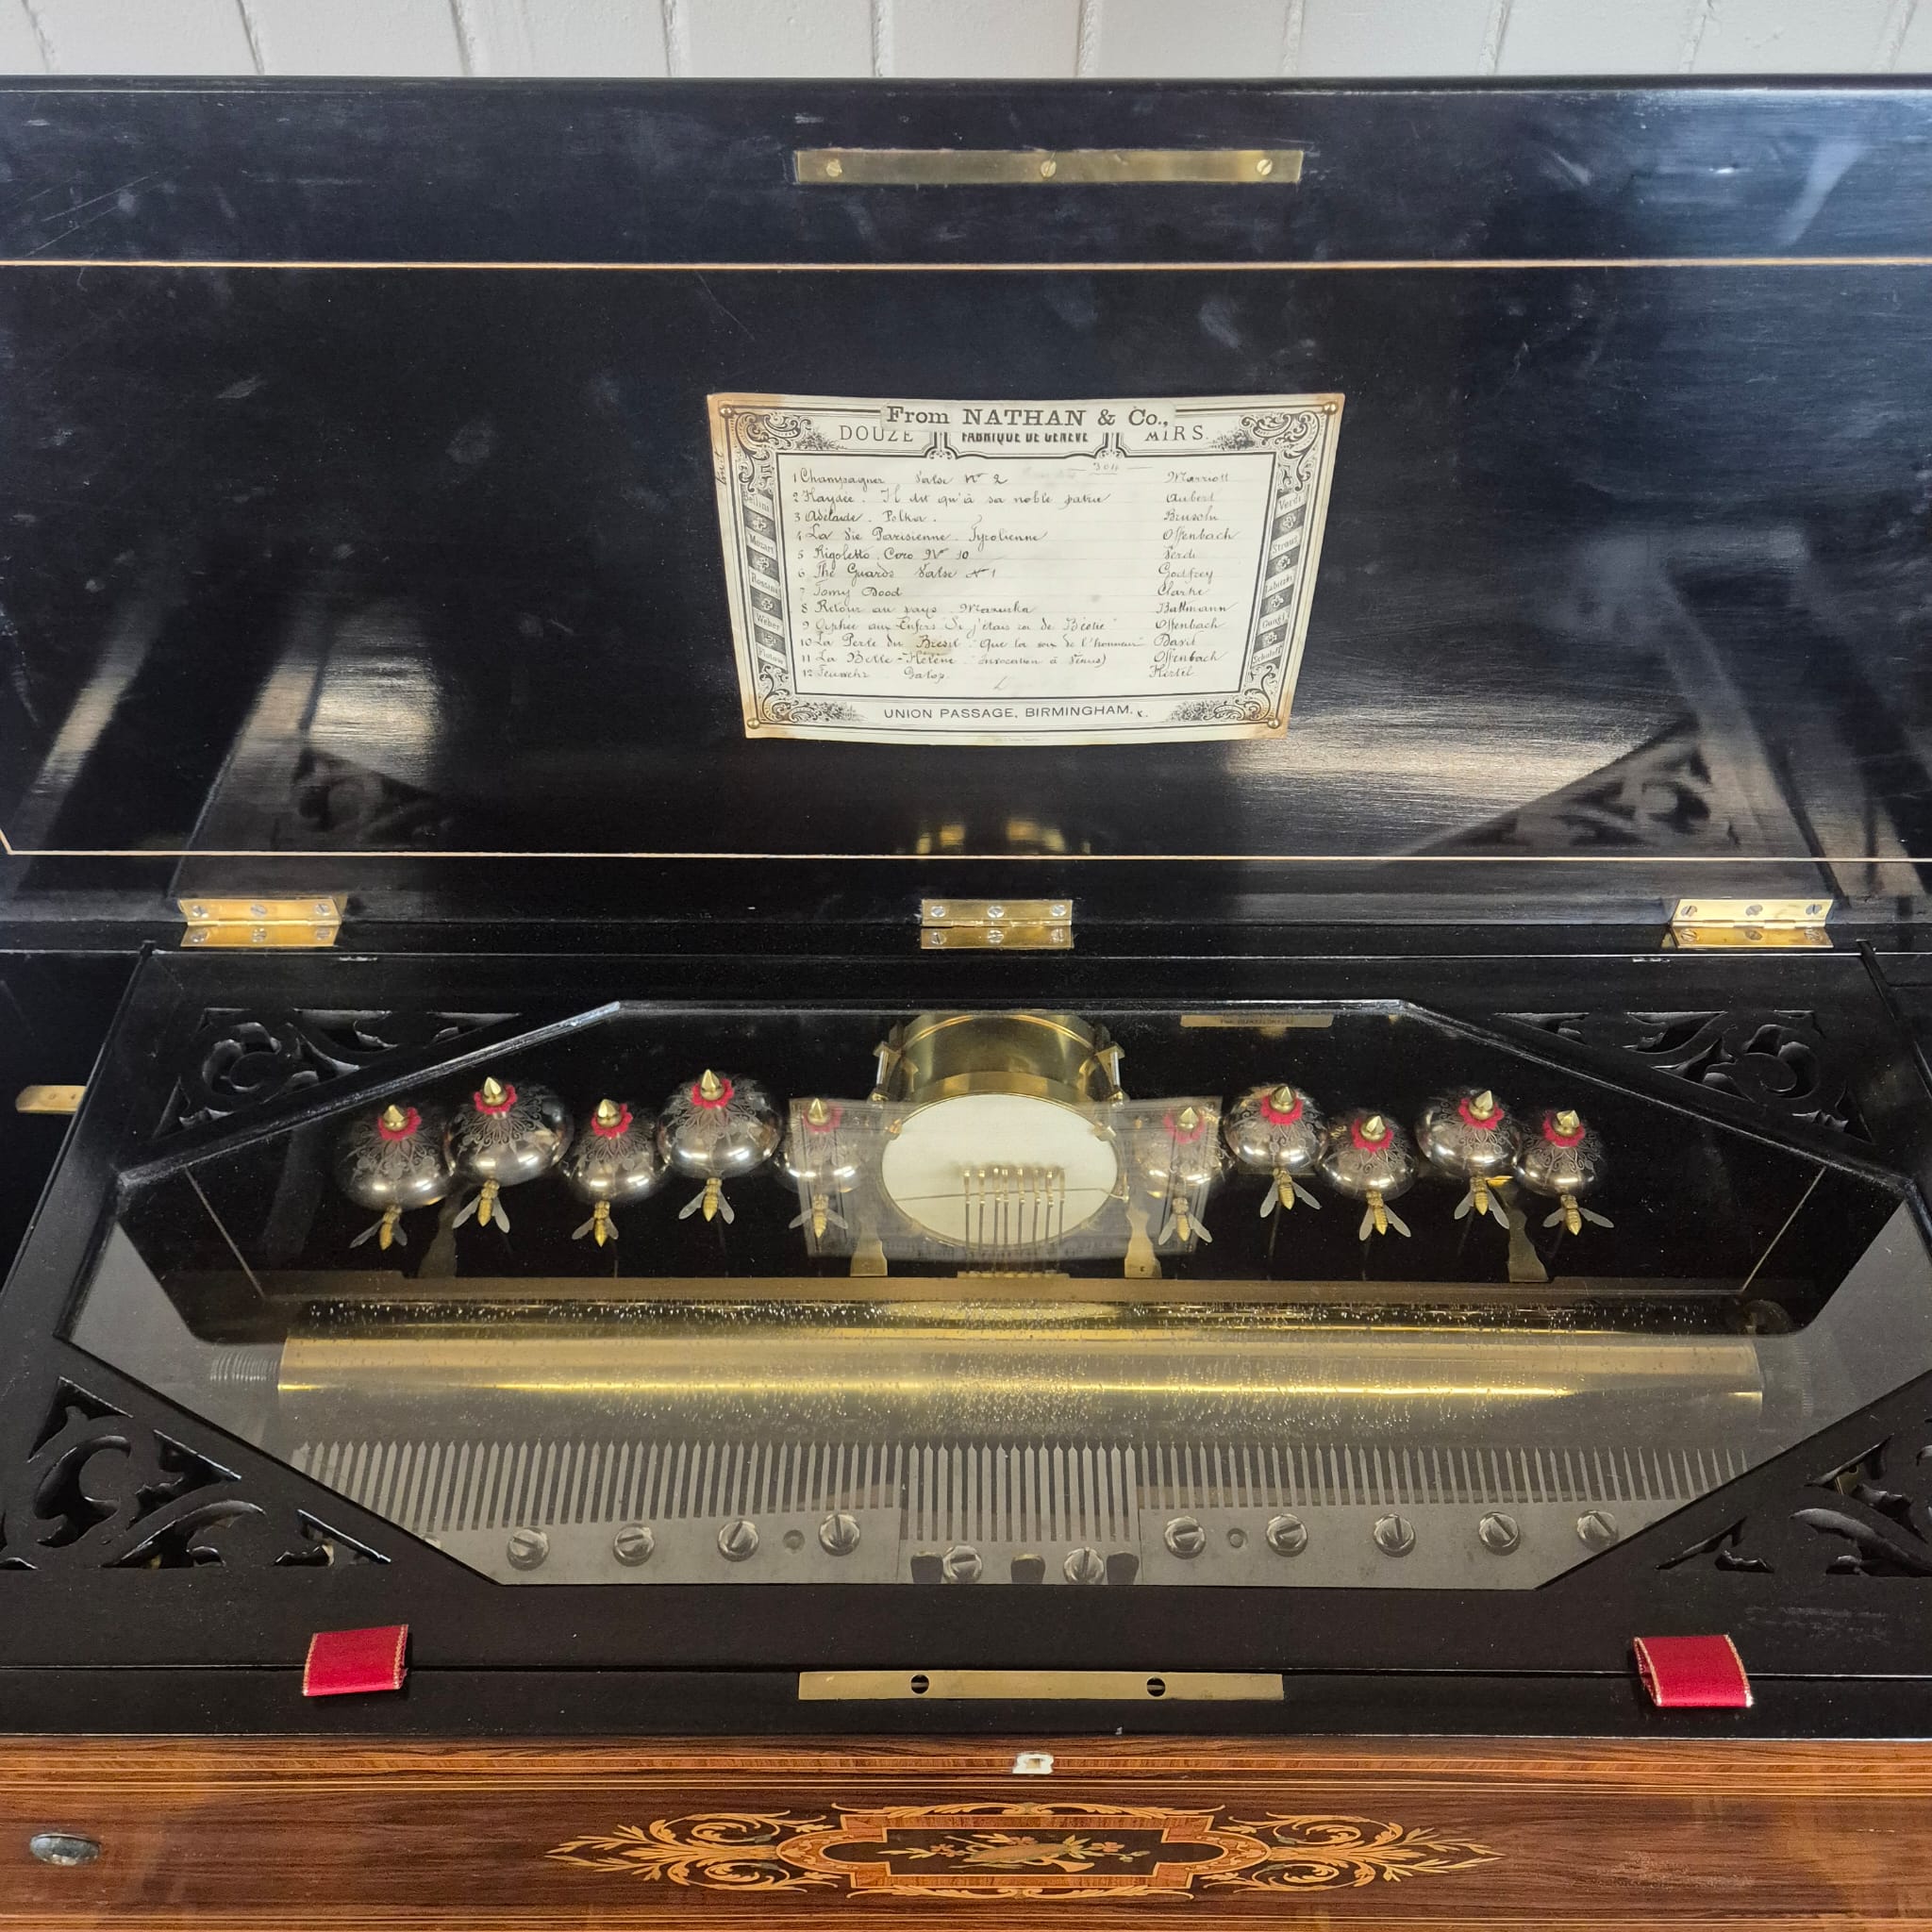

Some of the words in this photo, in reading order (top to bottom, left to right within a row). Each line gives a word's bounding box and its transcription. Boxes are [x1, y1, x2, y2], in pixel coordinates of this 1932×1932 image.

[887, 406, 950, 424] From
[962, 408, 1086, 425] NATHAN
[1097, 408, 1116, 425] &
[1128, 406, 1168, 427] Co.,
[840, 425, 913, 441] DOUZE
[993, 474, 1008, 485] 2
[1279, 494, 1301, 509] Verdi
[748, 532, 774, 555] Mozart
[1158, 562, 1213, 584] Godfrey
[757, 612, 780, 631] Weber
[801, 638, 811, 646] 10
[884, 708, 932, 718] UNION
[940, 708, 1018, 719] PASSAGE,
[1025, 705, 1132, 718] BIRMINGHAM.
